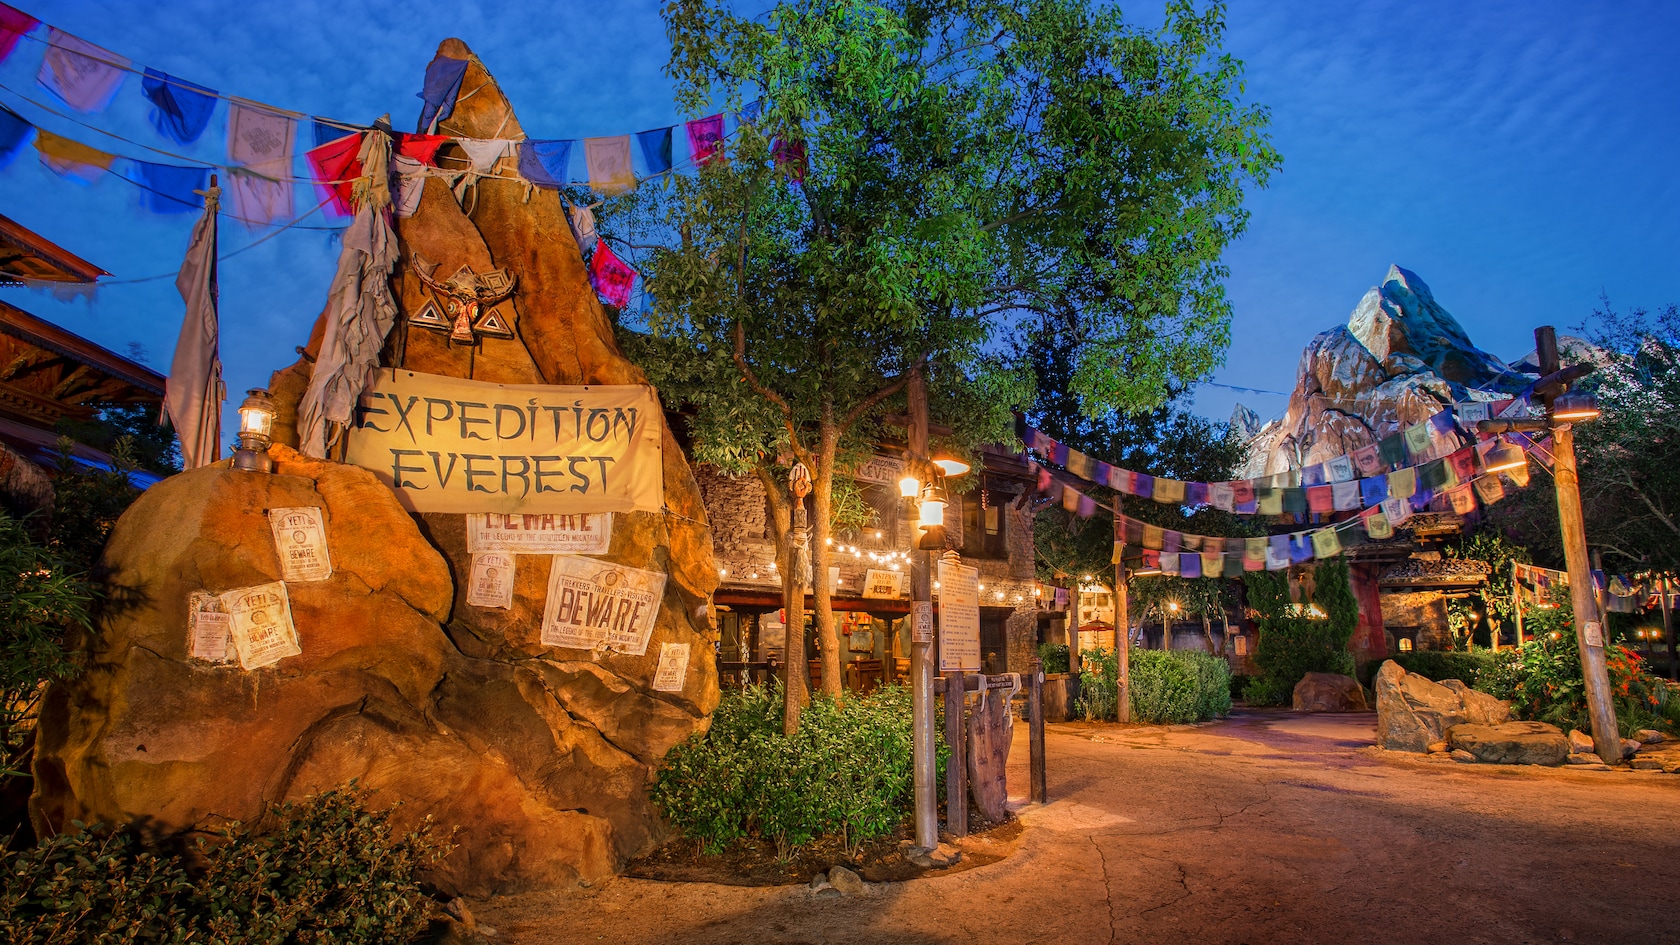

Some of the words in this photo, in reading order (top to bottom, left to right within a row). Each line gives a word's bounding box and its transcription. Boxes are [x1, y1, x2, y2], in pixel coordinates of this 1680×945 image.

[355, 392, 638, 445] EXPEDITION
[389, 448, 618, 500] EVEREST
[287, 515, 306, 526] YETI
[480, 532, 490, 541] THE
[289, 549, 316, 560] BEWARE
[487, 555, 502, 565] YETI
[561, 578, 590, 591] TREKKERS
[594, 584, 624, 597] TRAVELERS
[243, 593, 267, 608] YETI
[556, 587, 646, 633] BEWARE
[248, 626, 279, 643] BEWARE
